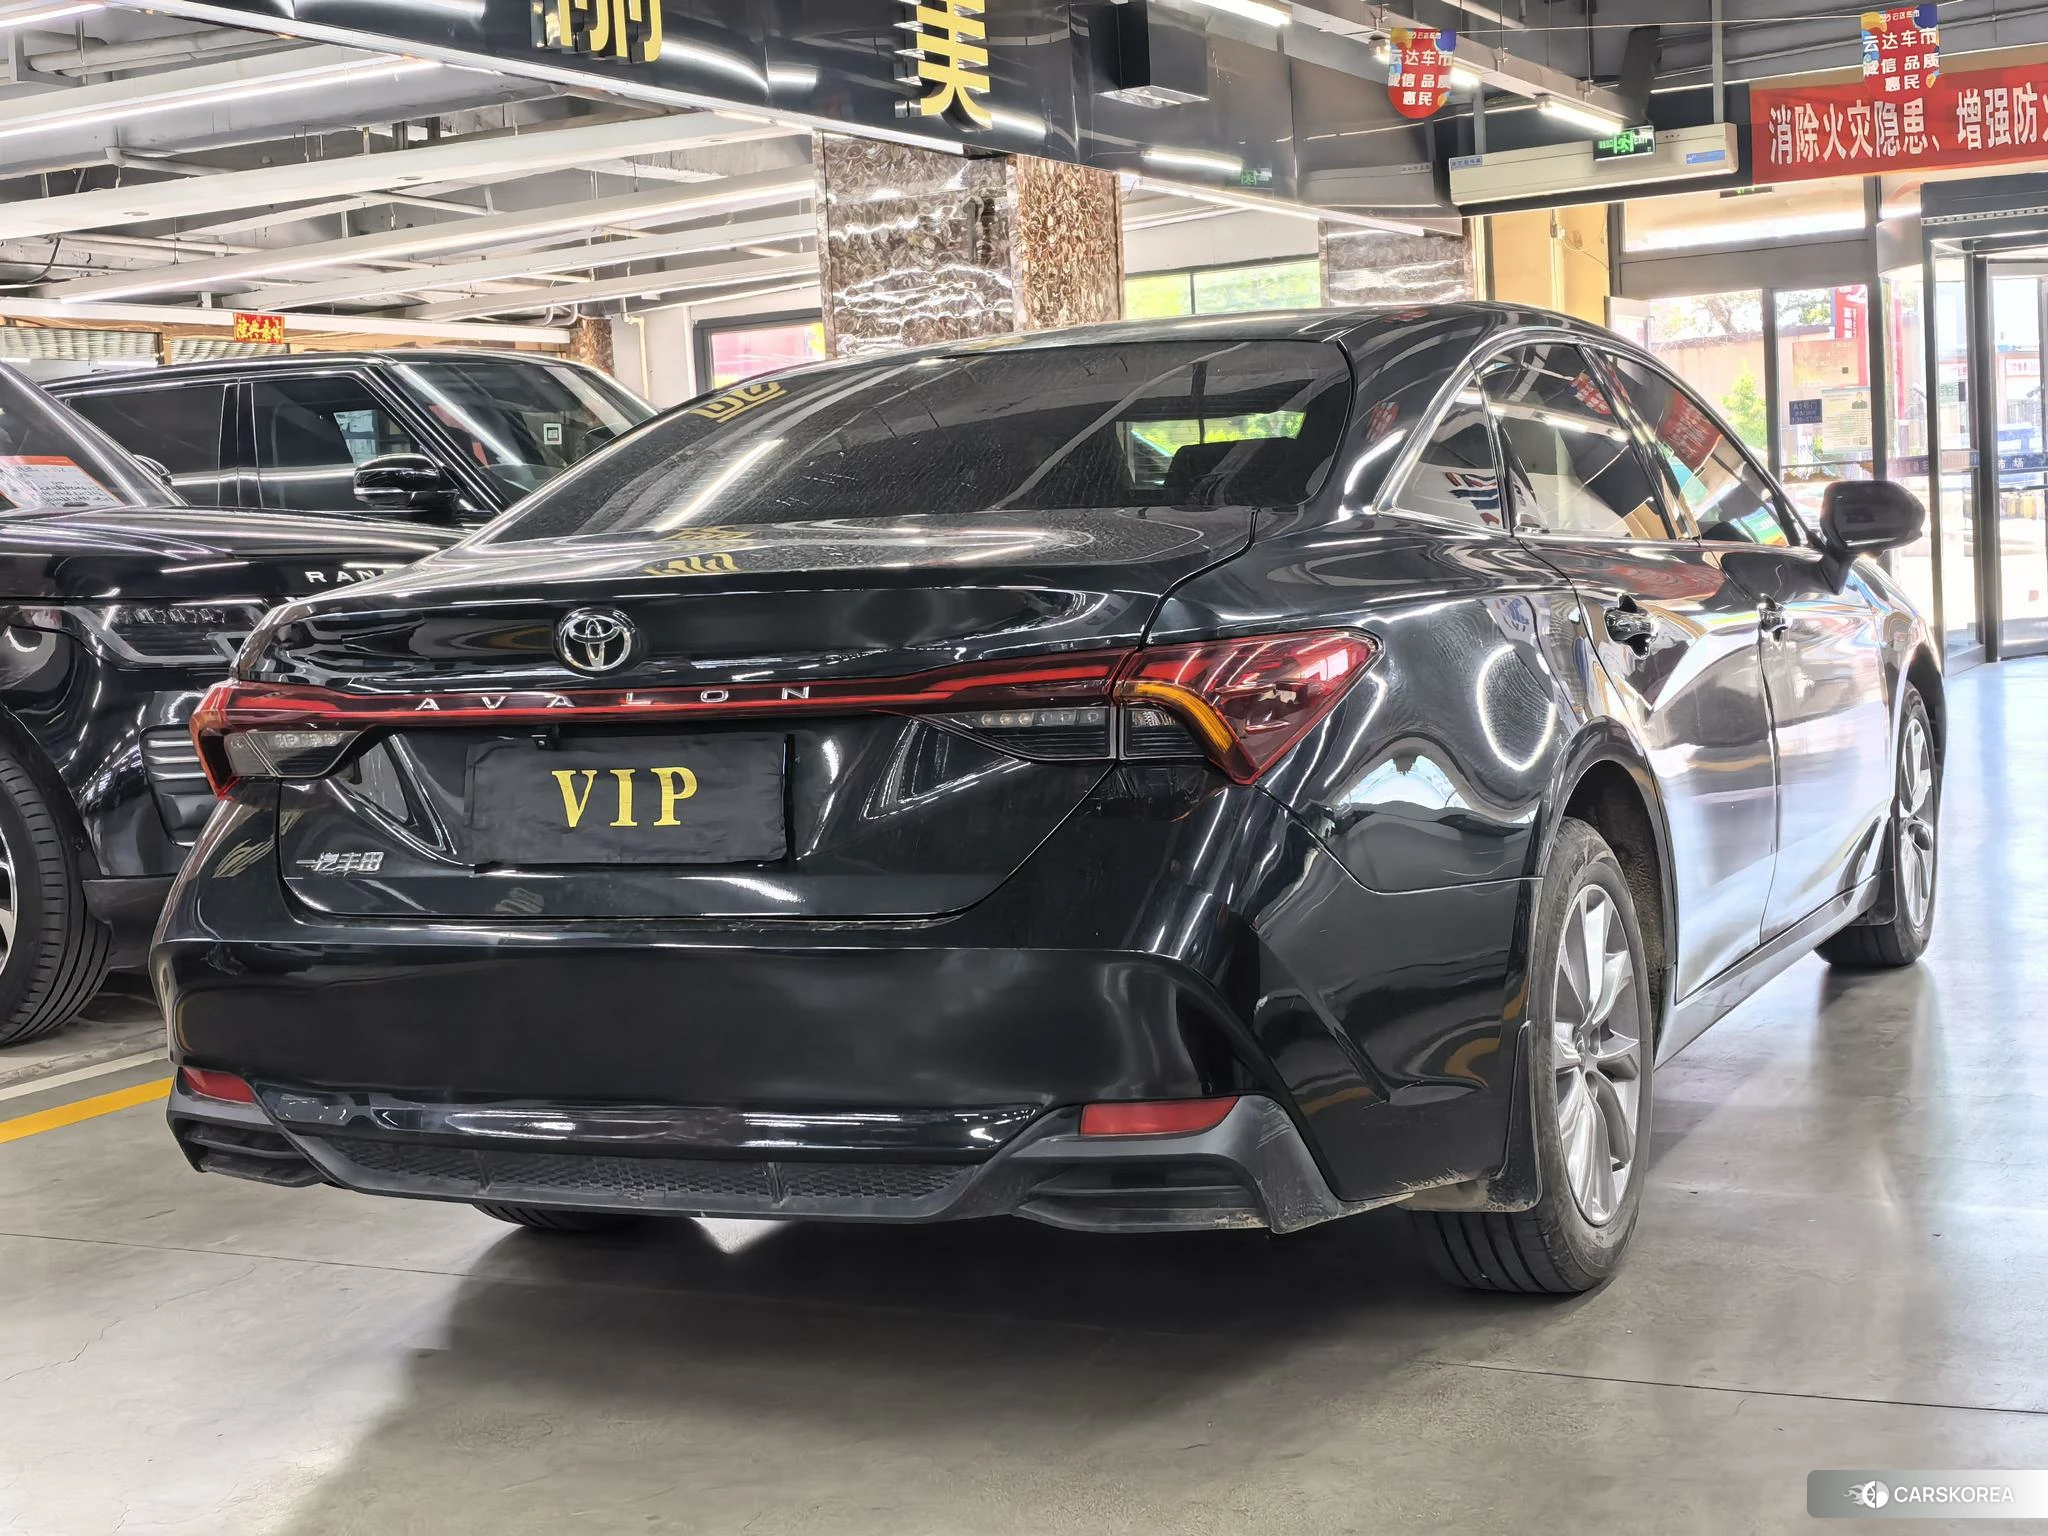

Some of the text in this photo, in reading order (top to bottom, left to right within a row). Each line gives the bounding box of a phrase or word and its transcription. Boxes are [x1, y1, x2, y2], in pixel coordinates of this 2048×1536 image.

[1863, 28, 1937, 52] 云达车市
[1885, 74, 1920, 92] 惠民
[1403, 91, 1432, 106] 惠民
[1769, 82, 2048, 164] 消除火灾隐患、增强防
[305, 569, 396, 583] RAN
[415, 685, 810, 711] AVALON
[551, 766, 698, 828] VIP
[296, 852, 384, 872] 一汽丰田
